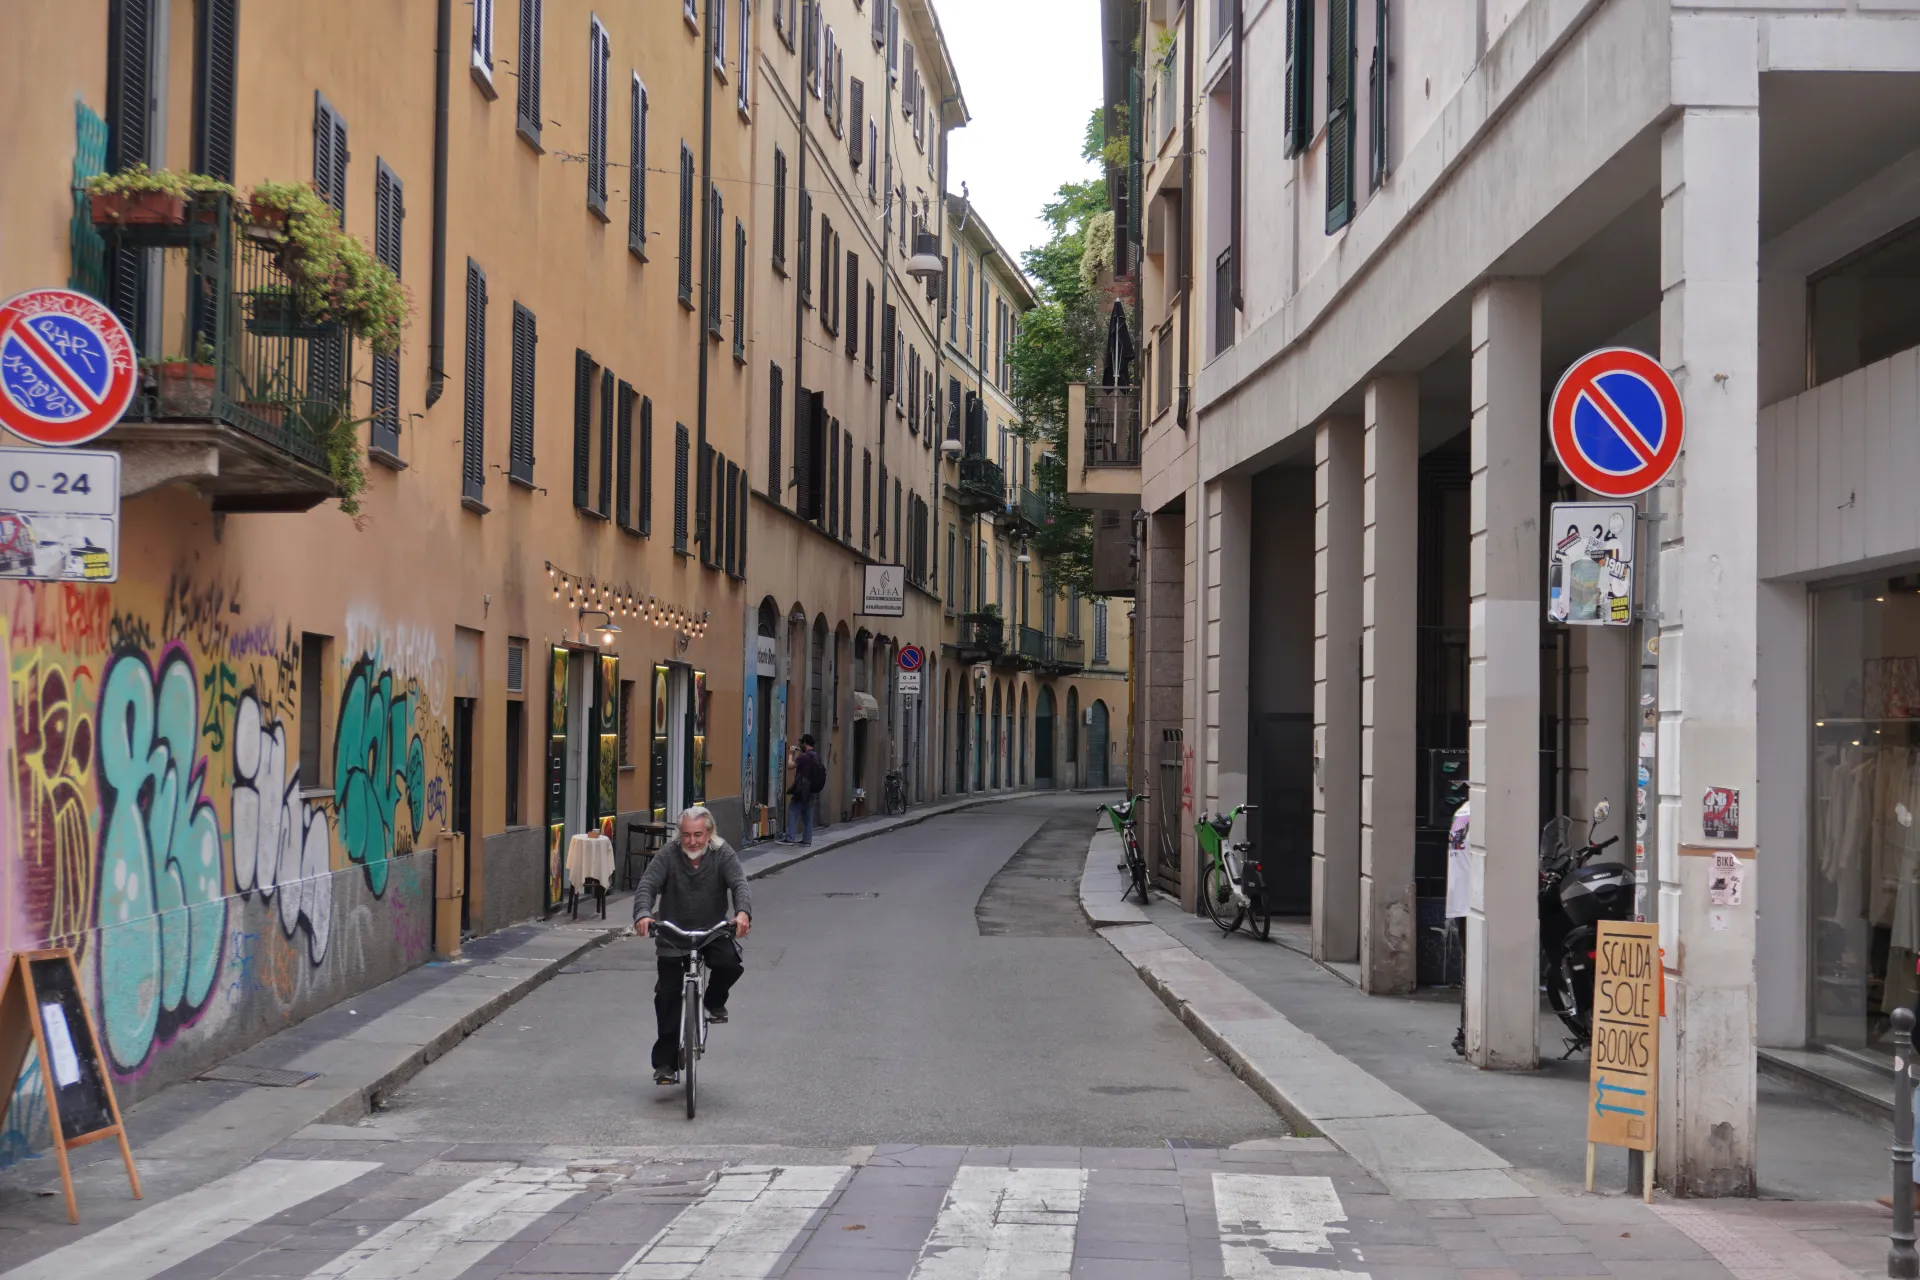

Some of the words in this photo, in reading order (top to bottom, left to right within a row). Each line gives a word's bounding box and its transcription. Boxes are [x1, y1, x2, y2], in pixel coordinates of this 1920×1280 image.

[1601, 940, 1652, 980] SCALDA
[1599, 979, 1651, 1019] SOLE
[1597, 1026, 1649, 1068] BOOKS
